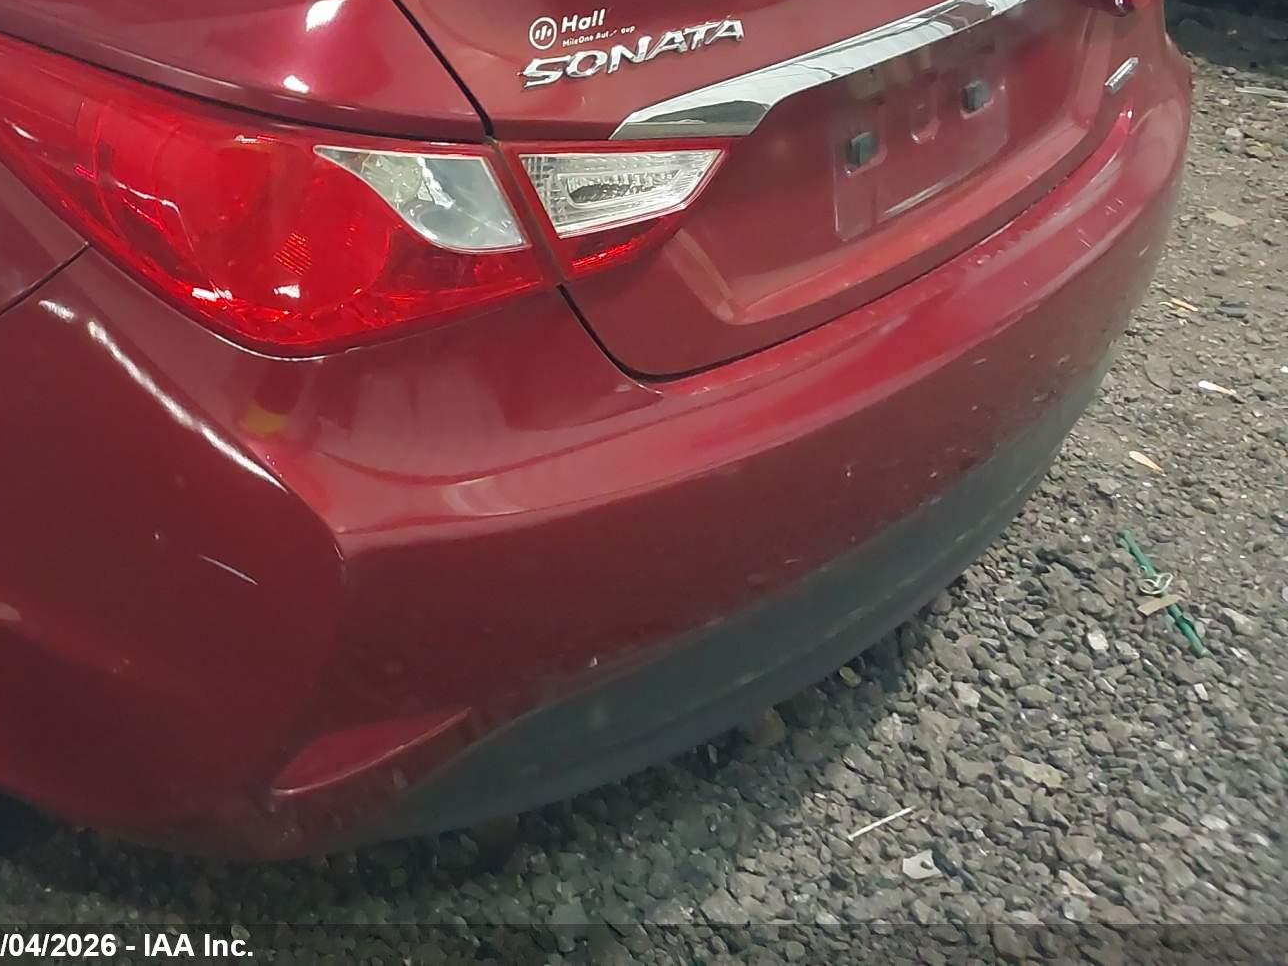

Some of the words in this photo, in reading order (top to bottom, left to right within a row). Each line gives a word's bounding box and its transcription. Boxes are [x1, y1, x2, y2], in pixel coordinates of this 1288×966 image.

[560, 8, 606, 33] Hall
[521, 17, 745, 88] SONATA
[562, 34, 594, 47] MileOne
